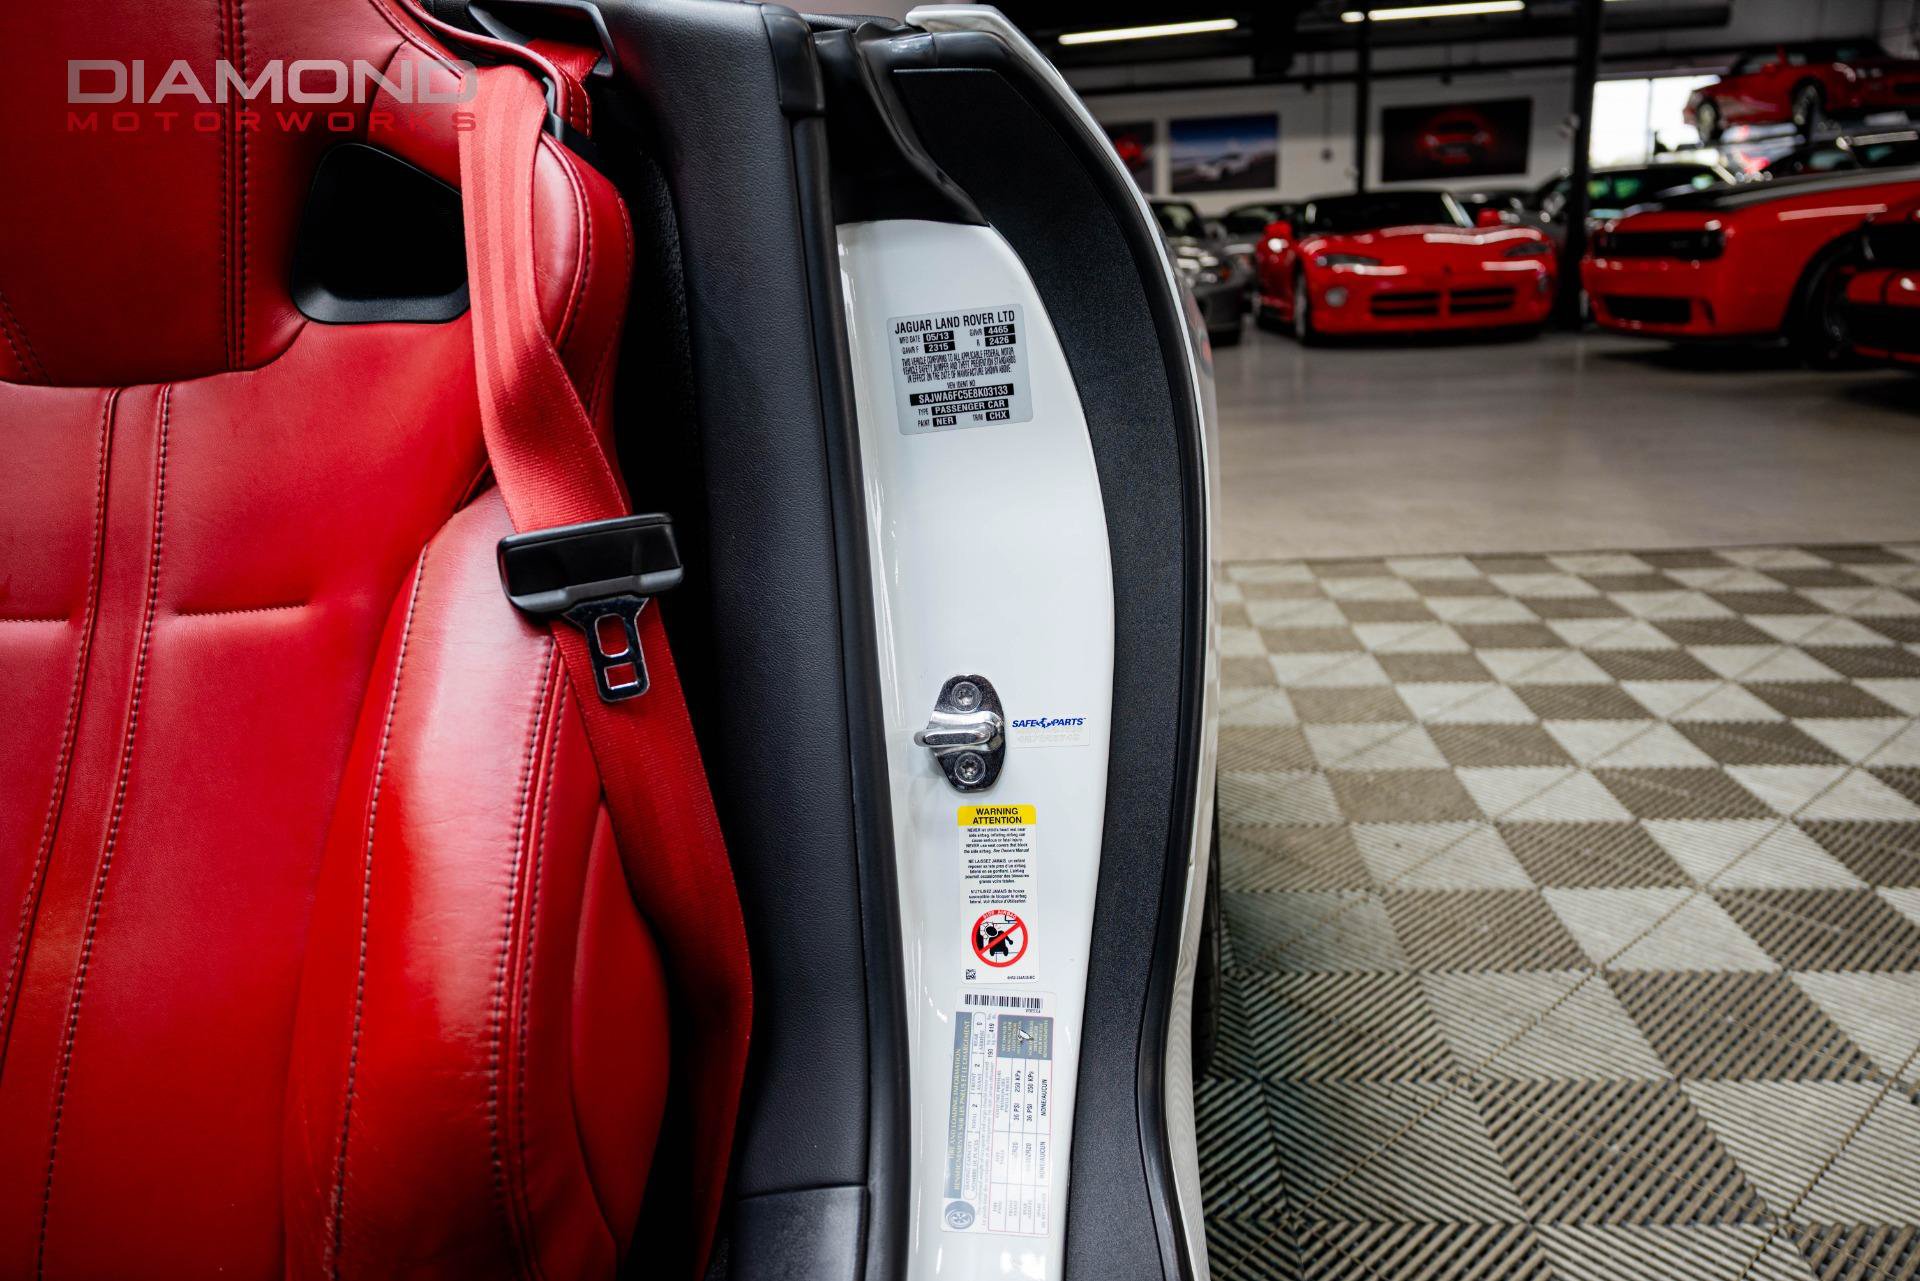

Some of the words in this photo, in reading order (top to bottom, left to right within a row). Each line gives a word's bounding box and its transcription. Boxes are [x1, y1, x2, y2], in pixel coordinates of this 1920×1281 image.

[894, 319, 932, 334] JAGUAR
[935, 316, 960, 330] LAND
[963, 312, 994, 326] ROVER
[997, 310, 1015, 323] LTD
[988, 325, 1009, 334] 4465
[926, 332, 950, 342] 05/13
[989, 337, 1009, 345] 2426
[928, 343, 949, 352] 2315
[919, 386, 1008, 404] SAJWA6FC5E8K03133
[935, 402, 985, 414] PASSENGER
[988, 400, 1005, 408] CAR
[990, 411, 1007, 420] CHX
[936, 417, 954, 426] NER
[1012, 719, 1038, 728] SAFE
[1052, 717, 1083, 726] PARTS
[973, 816, 1022, 824] ATTENTION
[952, 1048, 961, 1092] INFORMATION
[1039, 1079, 1049, 1116] NONE/AUCUN
